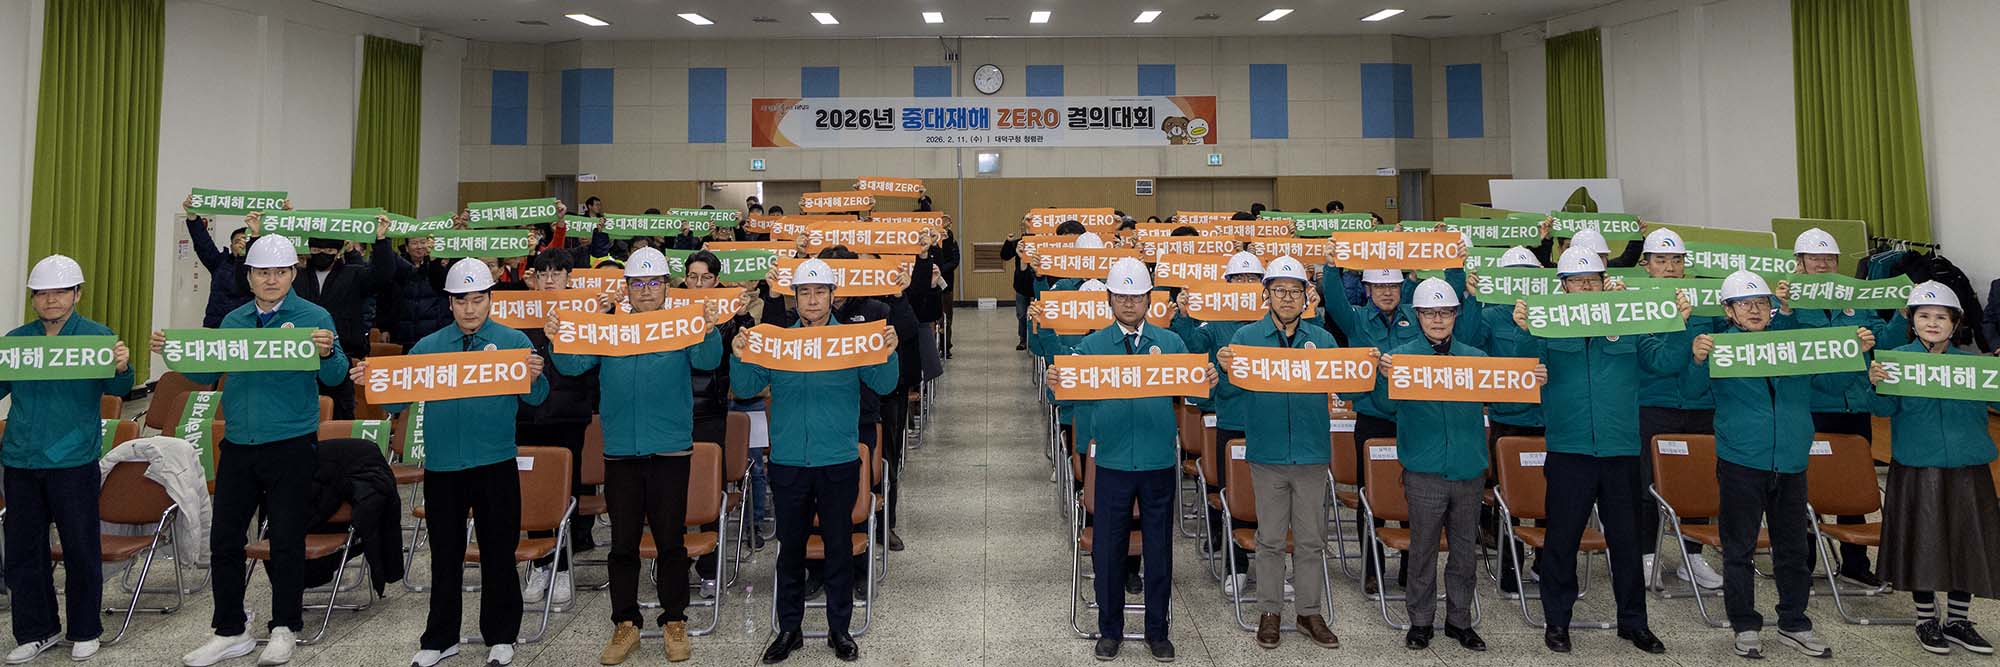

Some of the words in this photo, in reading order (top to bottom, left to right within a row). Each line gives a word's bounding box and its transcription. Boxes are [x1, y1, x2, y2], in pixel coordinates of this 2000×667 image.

[815, 107, 894, 129] 2026년
[902, 107, 989, 129] 중대재해
[996, 107, 1060, 128] ZERO
[1067, 106, 1154, 128] 결의대회
[970, 135, 983, 144] (수)
[859, 179, 894, 192] 중대재해
[895, 182, 920, 192] ZERO
[191, 194, 244, 209] 중대재해
[247, 198, 285, 210] ZERO
[805, 196, 841, 208] 중대재해
[843, 195, 870, 207] ZERO
[469, 206, 518, 222] 중대재해
[520, 205, 557, 219] ZERO
[1080, 214, 1114, 226] ZERO
[263, 215, 327, 232] 중대재해
[331, 218, 376, 235] ZERO
[604, 217, 648, 230] 중대재해
[651, 219, 682, 230] ZERO
[1257, 225, 1288, 236] ZERO
[1296, 218, 1339, 231] 중대재해
[1341, 219, 1372, 230] ZERO
[1502, 225, 1539, 239] ZERO
[1602, 219, 1639, 233] ZERO
[434, 236, 488, 251] 중대재해
[490, 237, 529, 250] ZERO
[808, 229, 871, 246] 중대재해
[874, 230, 920, 245] ZERO
[1144, 240, 1195, 256] 중대재해
[1198, 240, 1234, 254] ZERO
[1254, 241, 1303, 257] 중대재해
[1335, 240, 1404, 261] 중대재해
[1407, 242, 1458, 259] ZERO
[1039, 255, 1096, 271] 중대재해
[1157, 261, 1217, 280] 중대재해
[1684, 250, 1746, 271] 중대재해
[1749, 255, 1797, 274] ZERO
[1478, 275, 1548, 296] 중대재해
[1788, 281, 1854, 302] 중대재해
[1857, 284, 1915, 301] ZERO
[1188, 292, 1257, 311] 중대재해
[1528, 302, 1613, 328] 중대재해
[1615, 301, 1678, 322] ZERO
[558, 320, 641, 346] 중대재해
[645, 316, 705, 342] ZERO
[164, 339, 249, 361] 중대재해
[253, 338, 316, 360] ZERO
[748, 331, 822, 361] 중대재해
[826, 333, 884, 357] ZERO
[1712, 340, 1797, 367] 중대재해
[1800, 338, 1859, 361] ZERO
[48, 348, 115, 367] ZERO
[369, 363, 458, 393] 중대재해
[462, 361, 528, 385] ZERO
[1059, 366, 1142, 389] 중대재해
[1146, 366, 1207, 386] ZERO
[1231, 356, 1312, 382] 중대재해
[1315, 360, 1373, 380] ZERO
[1391, 365, 1474, 390] 중대재해
[1478, 369, 1537, 390] ZERO
[1881, 361, 1977, 389] 중대재해
